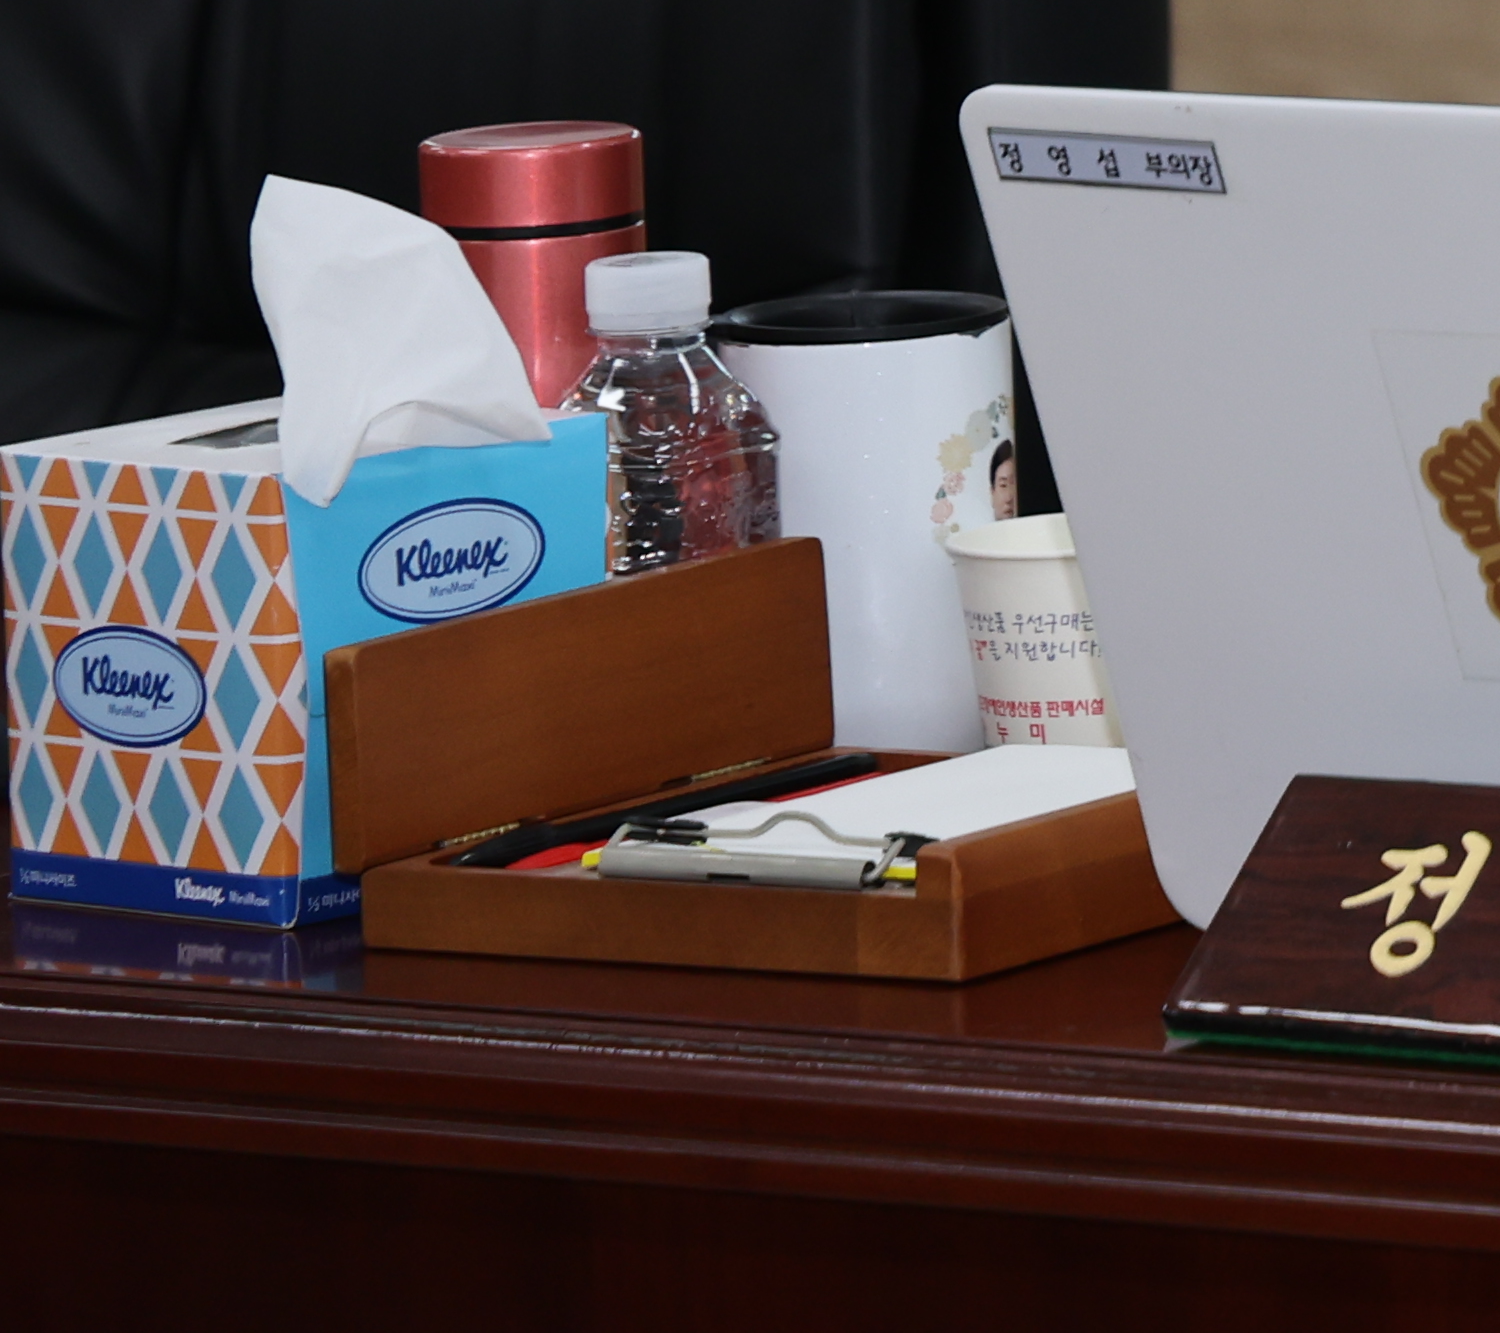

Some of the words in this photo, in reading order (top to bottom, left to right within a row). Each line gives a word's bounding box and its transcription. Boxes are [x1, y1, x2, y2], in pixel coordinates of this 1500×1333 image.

[1146, 152, 1214, 186] 부의장
[395, 536, 508, 587] Kleenex
[1012, 611, 1094, 634] 우선구매는
[82, 653, 175, 711] Kleenex
[1045, 698, 1105, 718] 판매시설
[1342, 831, 1492, 978] 정
